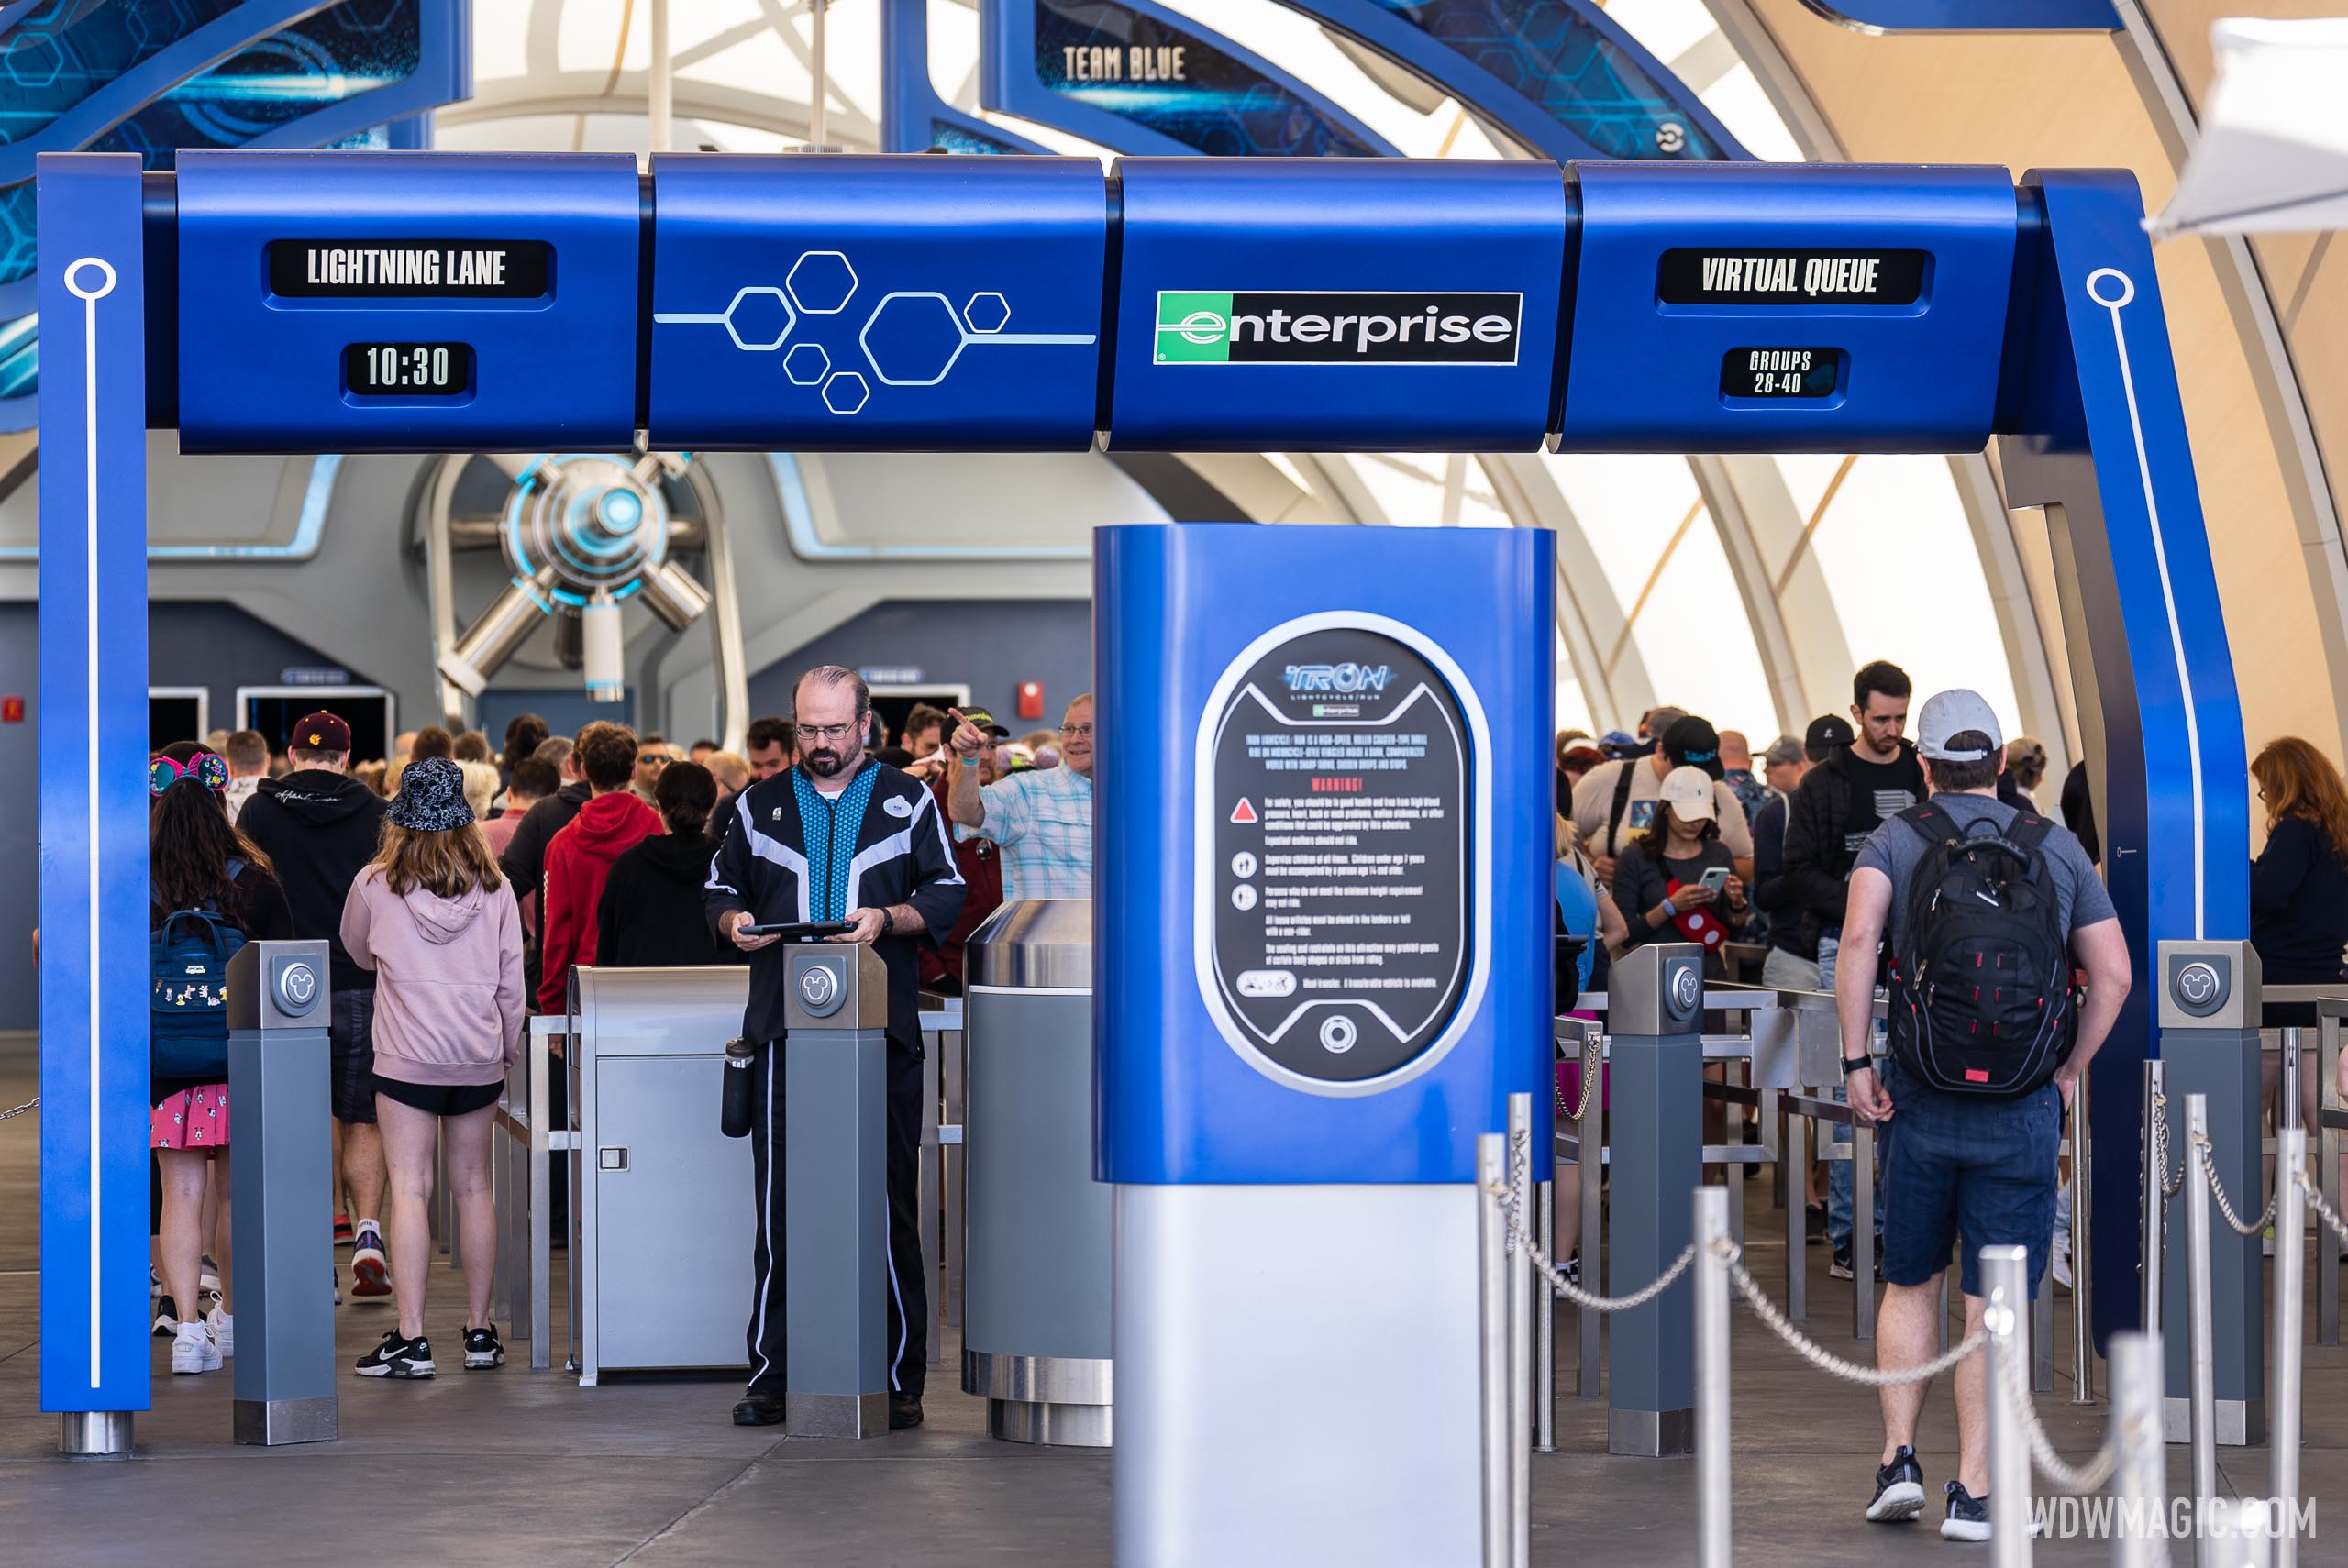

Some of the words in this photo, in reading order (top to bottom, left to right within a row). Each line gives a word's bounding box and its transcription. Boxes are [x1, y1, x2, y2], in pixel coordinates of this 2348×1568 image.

[1063, 46, 1121, 81] TEAM
[1129, 46, 1186, 81] BLUE
[307, 249, 440, 285] LIGHTNING
[446, 250, 506, 285] LANE
[1702, 258, 1798, 293] VIRTUAL
[1803, 258, 1880, 297] QUEUE
[1178, 305, 1512, 353] enterprise
[367, 348, 449, 386] 10:30
[1749, 350, 1811, 371] GROUPS
[1754, 373, 1801, 394] 28-40
[1284, 661, 1389, 693] TRON
